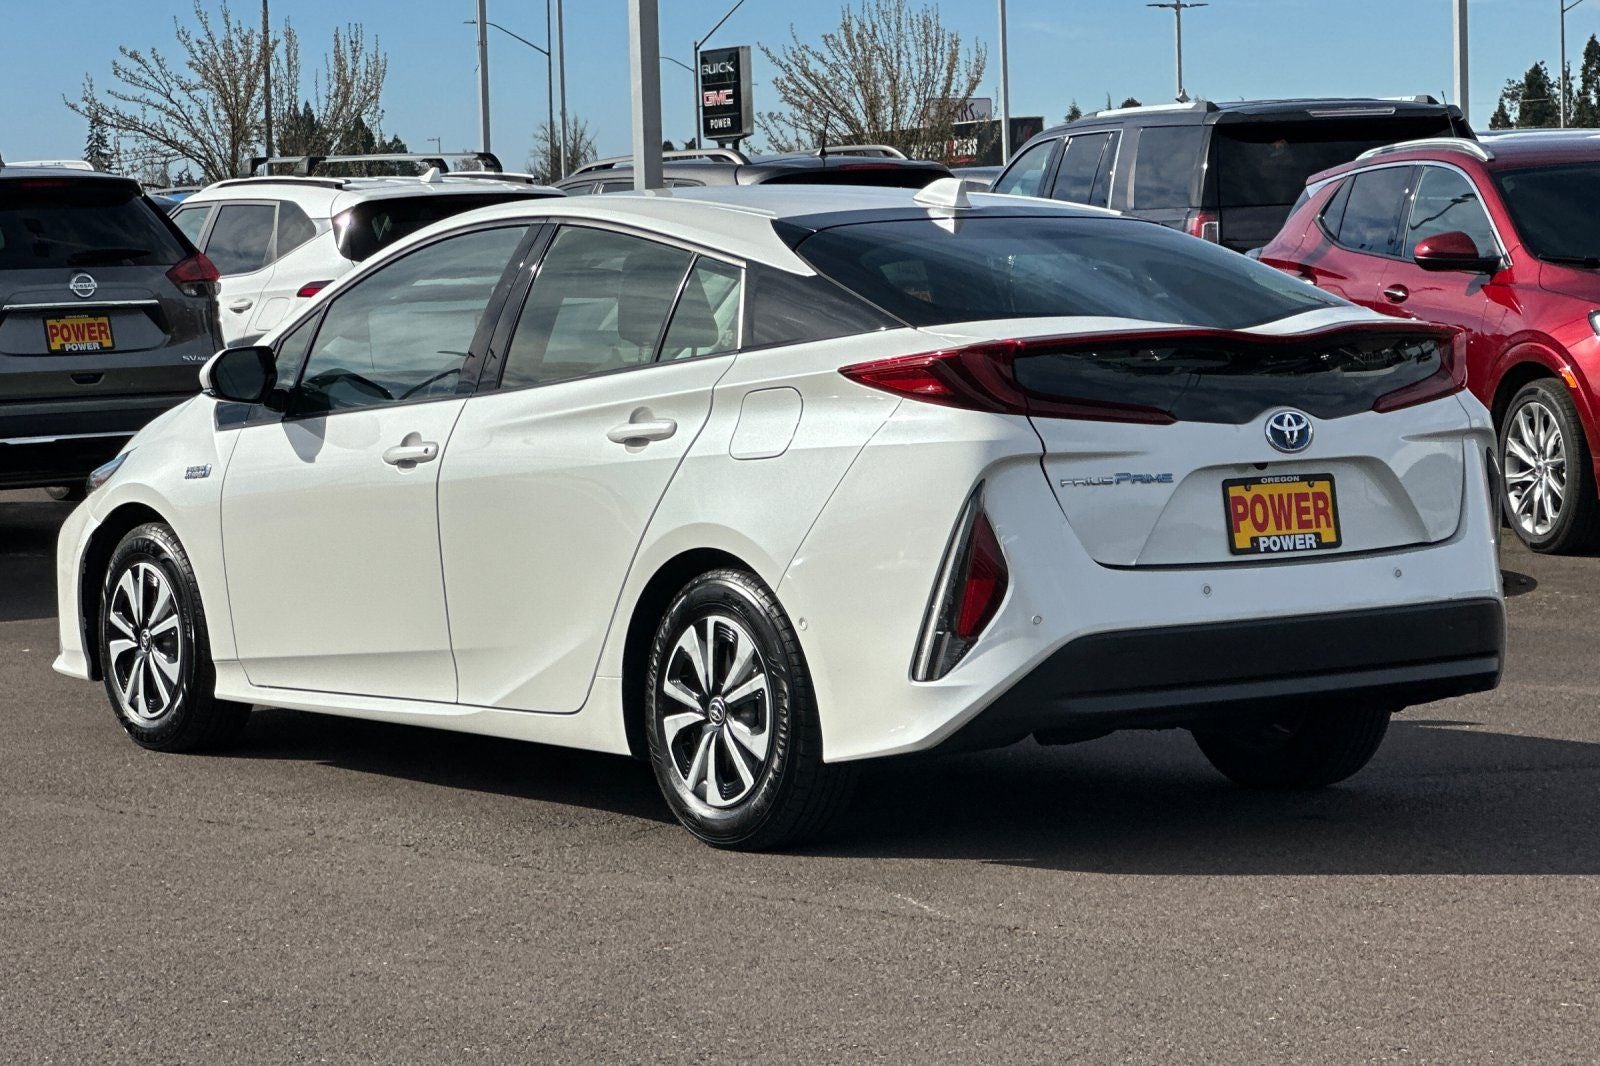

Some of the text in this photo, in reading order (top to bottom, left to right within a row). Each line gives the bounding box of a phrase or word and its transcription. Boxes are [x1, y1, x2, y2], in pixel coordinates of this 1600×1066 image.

[701, 61, 734, 75] BUICK
[703, 89, 734, 107] GMC
[710, 118, 731, 129] POWER
[49, 322, 109, 343] POWER
[65, 342, 100, 351] POWER
[1260, 476, 1300, 484] OREGON
[1230, 491, 1332, 533] POWER
[1259, 534, 1317, 552] POWER
